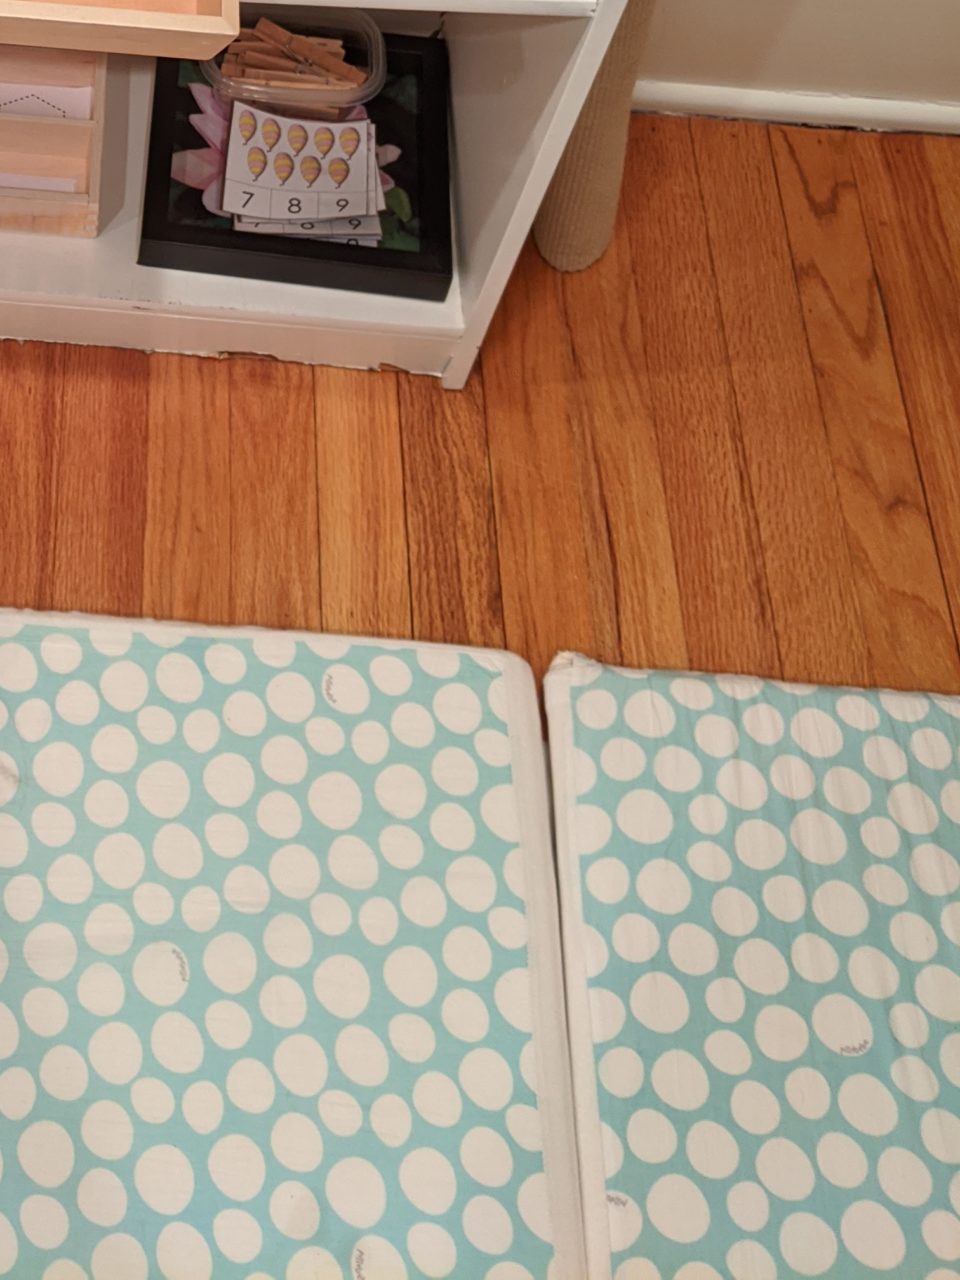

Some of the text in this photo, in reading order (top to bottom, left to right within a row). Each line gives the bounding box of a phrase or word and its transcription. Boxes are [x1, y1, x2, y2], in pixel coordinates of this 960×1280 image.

[242, 191, 349, 214] 7 8 9
